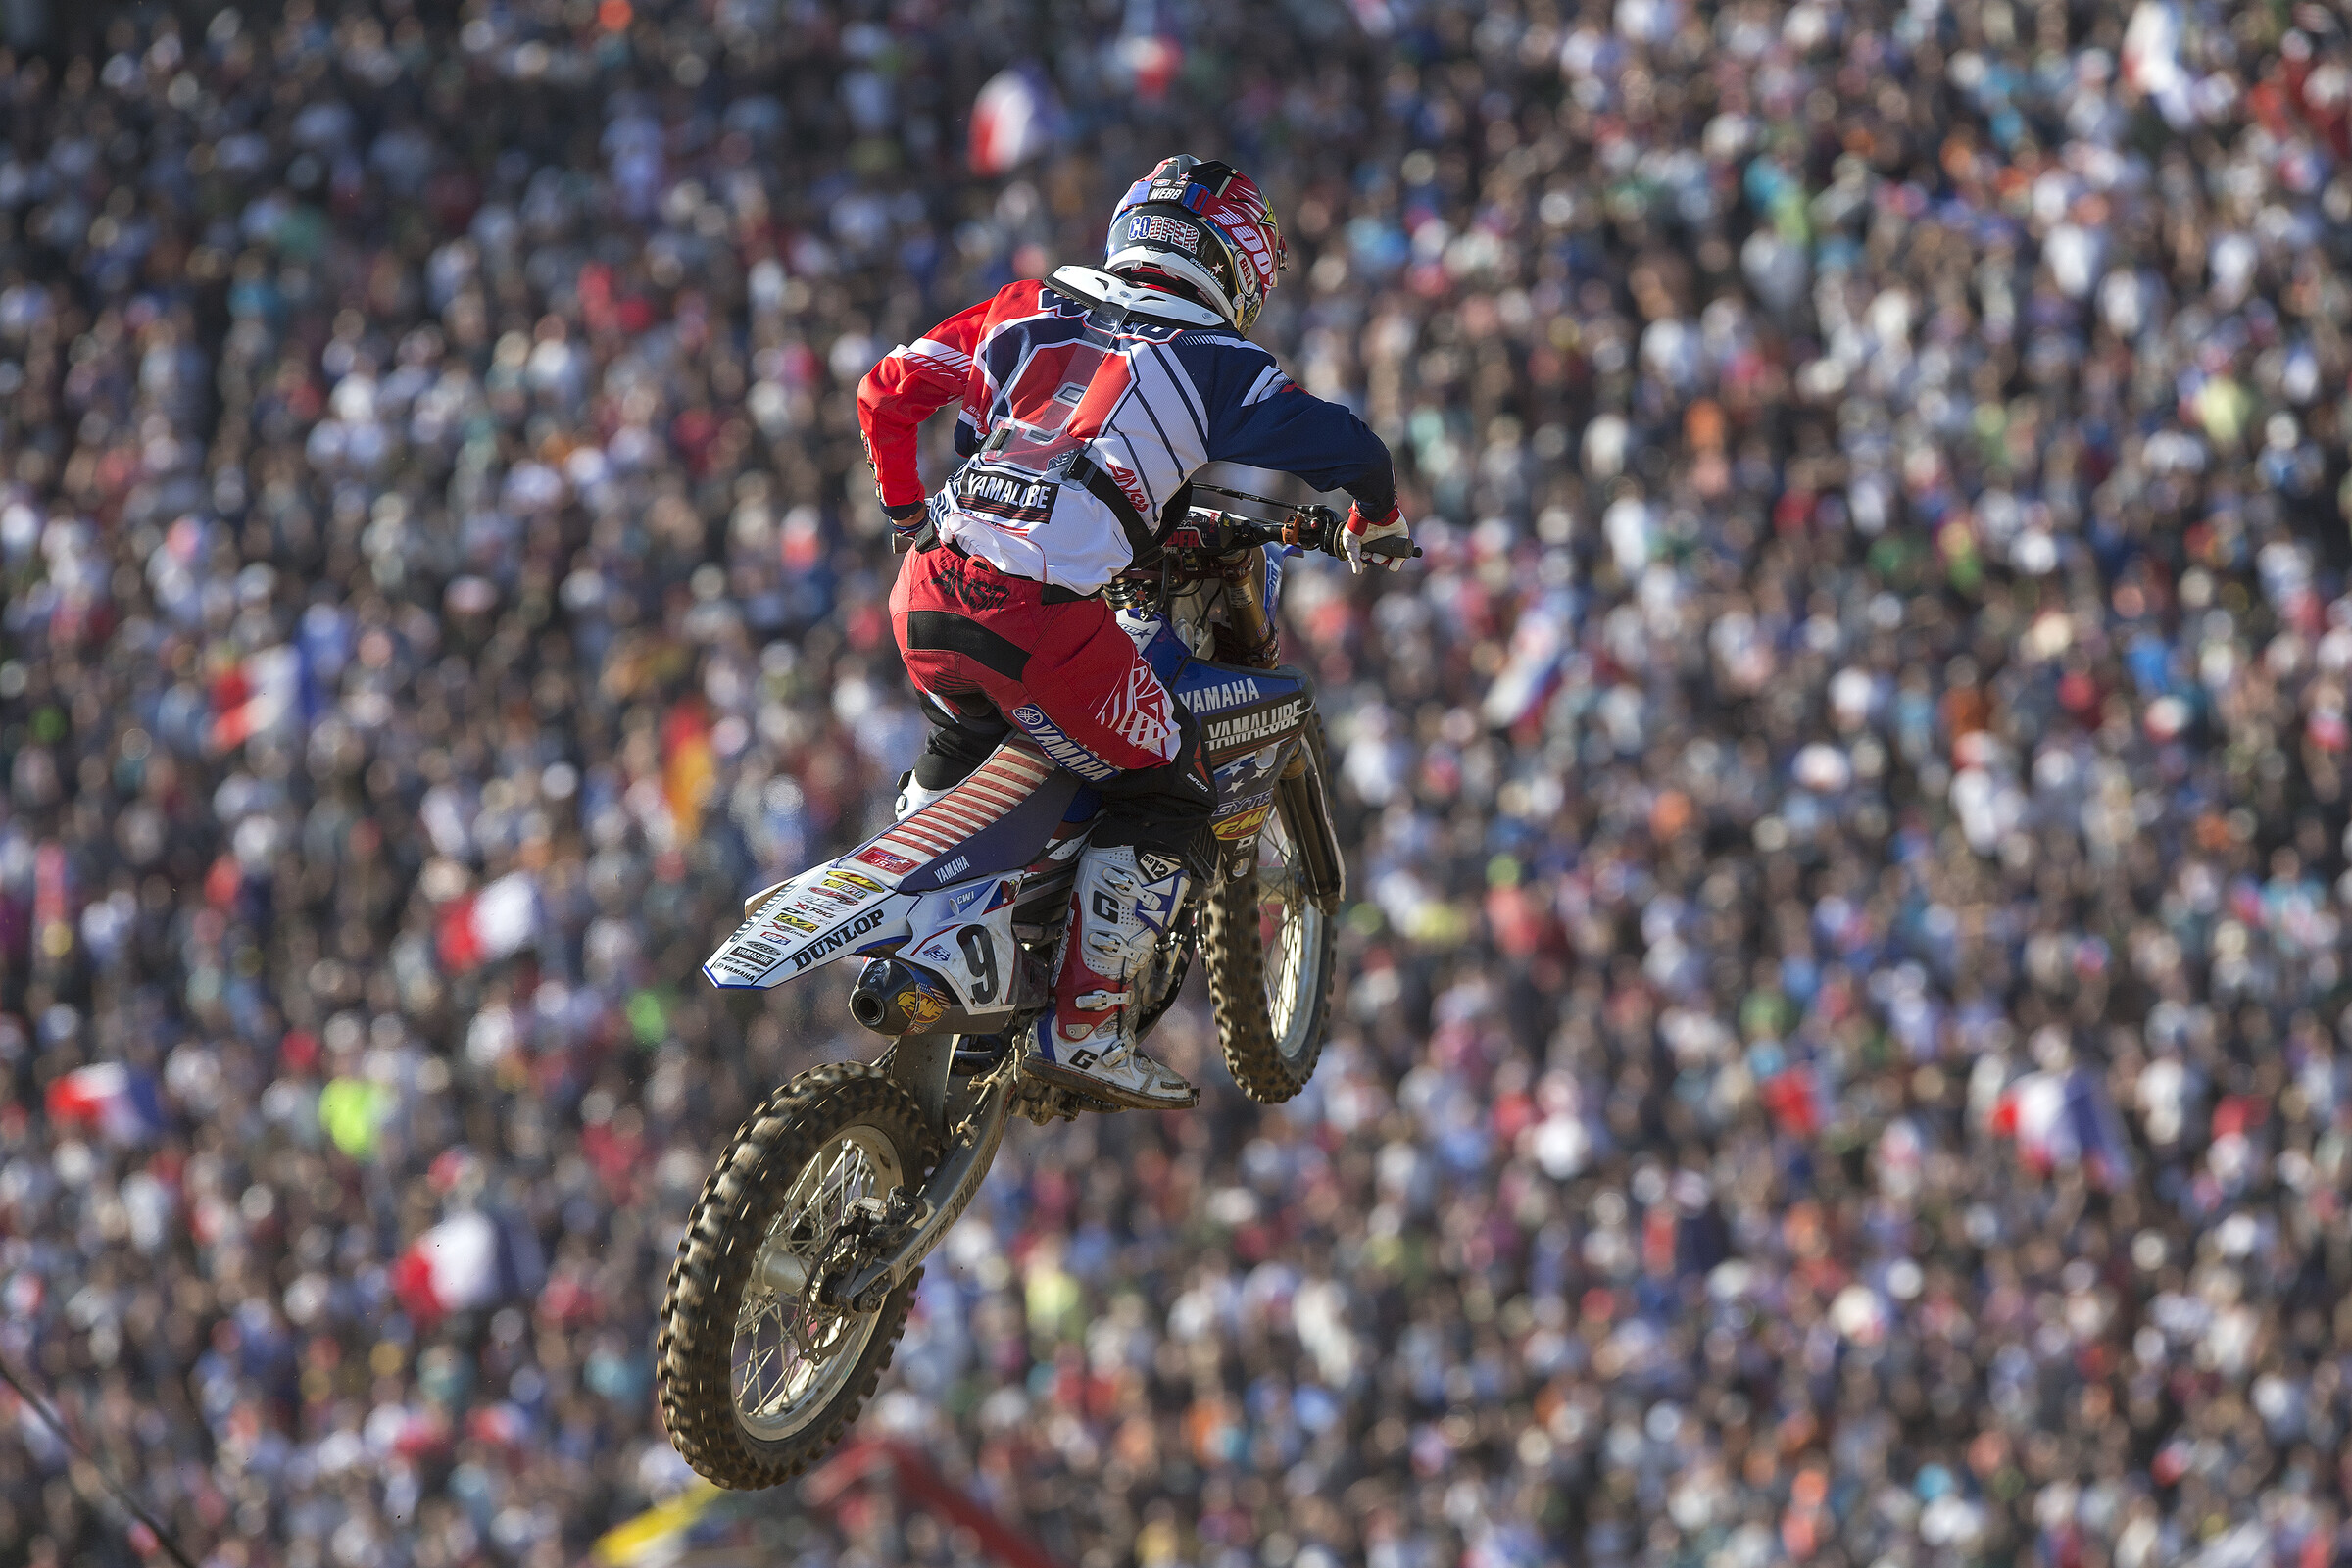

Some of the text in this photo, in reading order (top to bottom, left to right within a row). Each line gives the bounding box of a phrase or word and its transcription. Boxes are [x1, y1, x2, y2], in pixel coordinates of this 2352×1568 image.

[1149, 187, 1183, 201] WEBB
[1128, 215, 1200, 255] COOPER
[1238, 257, 1253, 290] BELL
[967, 472, 1051, 510] YAMALUBE
[1178, 677, 1260, 713] YAMAHA
[1206, 698, 1301, 752] YAMALUBE
[1029, 725, 1113, 781] YAMAHA
[933, 855, 970, 884] YAMAHA
[1150, 859, 1169, 878] 12
[736, 947, 772, 964] YAMALUBE
[791, 908, 885, 972] DUNLOP
[723, 964, 756, 982] YAMAHA
[956, 923, 999, 1004] 9
[897, 992, 944, 1019] FMF
